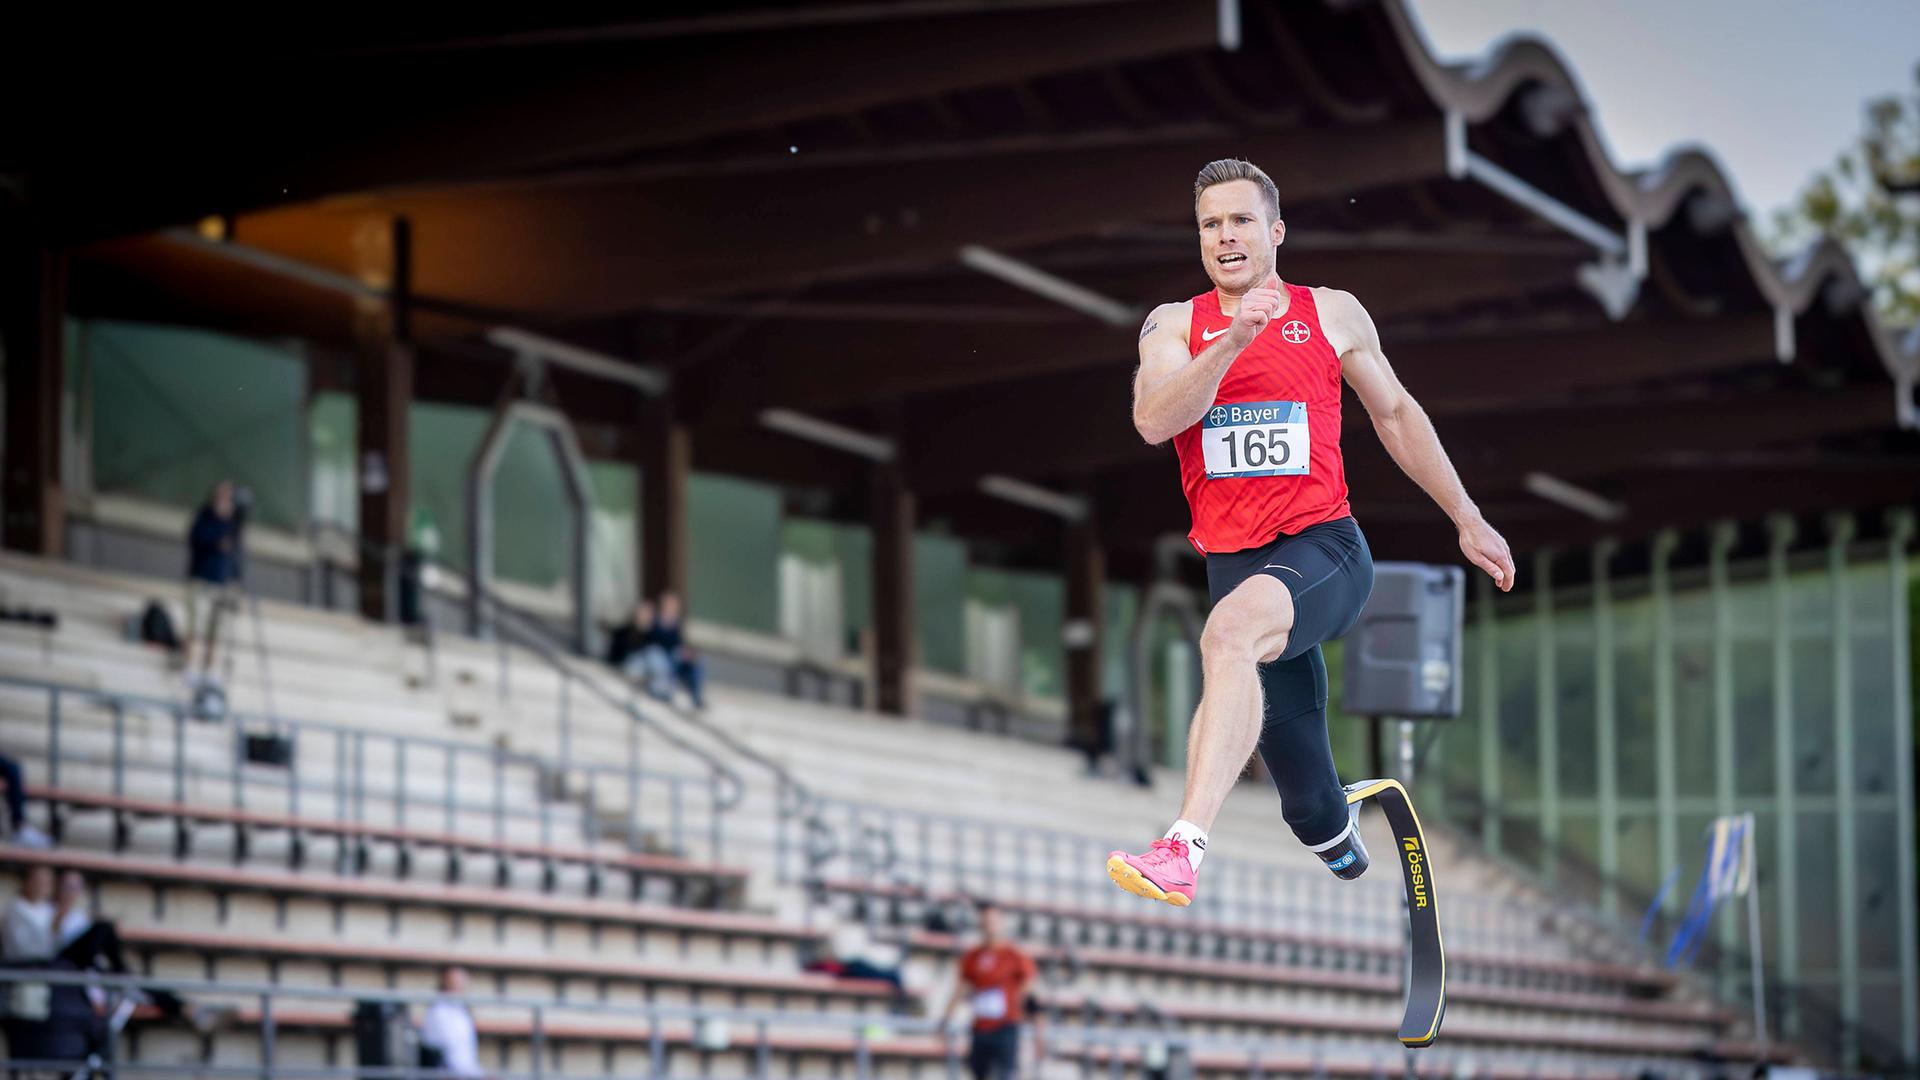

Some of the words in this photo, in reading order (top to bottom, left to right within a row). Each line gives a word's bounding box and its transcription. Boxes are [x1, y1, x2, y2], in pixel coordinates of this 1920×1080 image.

[1231, 407, 1280, 424] Bayer
[1221, 428, 1291, 468] 165
[1408, 851, 1428, 908] ÖSSUR
